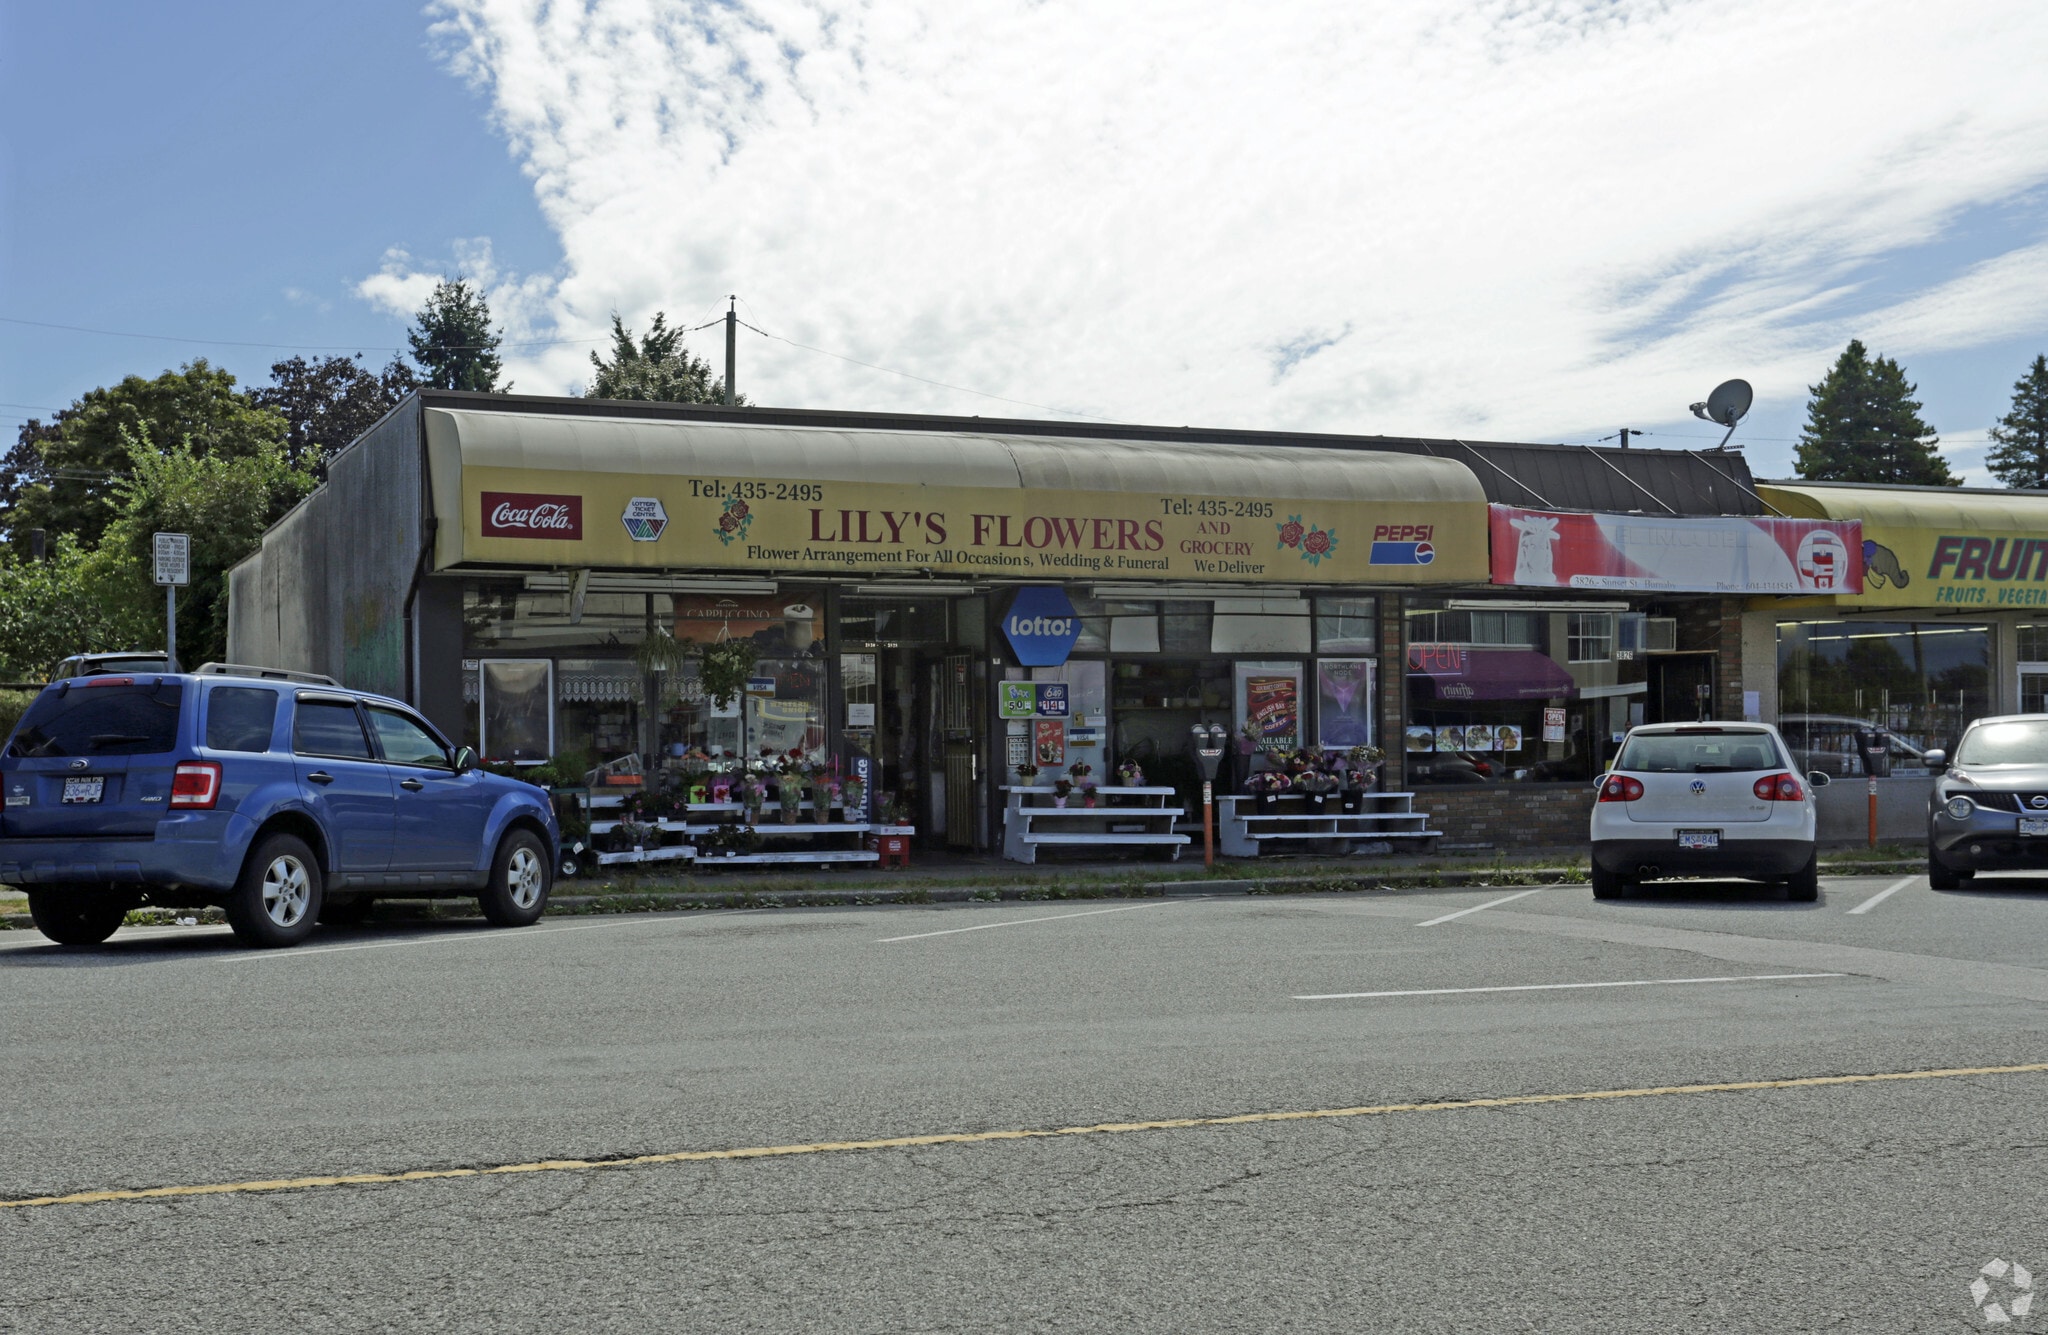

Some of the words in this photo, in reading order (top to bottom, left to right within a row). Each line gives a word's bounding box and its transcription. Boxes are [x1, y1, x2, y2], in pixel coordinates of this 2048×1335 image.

[688, 480, 727, 498] Tel:
[731, 482, 823, 501] 435-2495
[491, 502, 569, 529] Coca-Cola
[1161, 498, 1193, 515] Tel:
[1197, 501, 1273, 518] 435-2495
[808, 508, 948, 545] LILY'S
[970, 513, 1164, 551] FLOWERS
[1196, 521, 1231, 535] AND
[1373, 525, 1434, 541] PEPSI
[1180, 540, 1254, 556] GROCERY
[747, 545, 800, 560] Flower
[802, 547, 902, 565] Arrangement
[906, 549, 930, 562] For
[933, 550, 953, 563] All
[957, 551, 1034, 567] Occasions,
[1039, 553, 1101, 571] Wedding
[1103, 557, 1114, 568] &
[1118, 556, 1169, 570] Funeral
[1194, 559, 1216, 572] We
[1218, 560, 1265, 574] Deliver
[1602, 578, 1627, 587] Sunset
[1644, 580, 1676, 589] Burnaby
[1010, 616, 1072, 636] lotto!
[1408, 643, 1460, 670] OPEN
[1256, 704, 1275, 720] ENGLISH
[1275, 703, 1286, 712] BAY
[1547, 713, 1562, 721] OPEN
[1264, 718, 1287, 730] COFFEE
[1260, 736, 1293, 745] AILABLE
[857, 759, 868, 819] Pronce
[2021, 822, 2037, 831] 398
